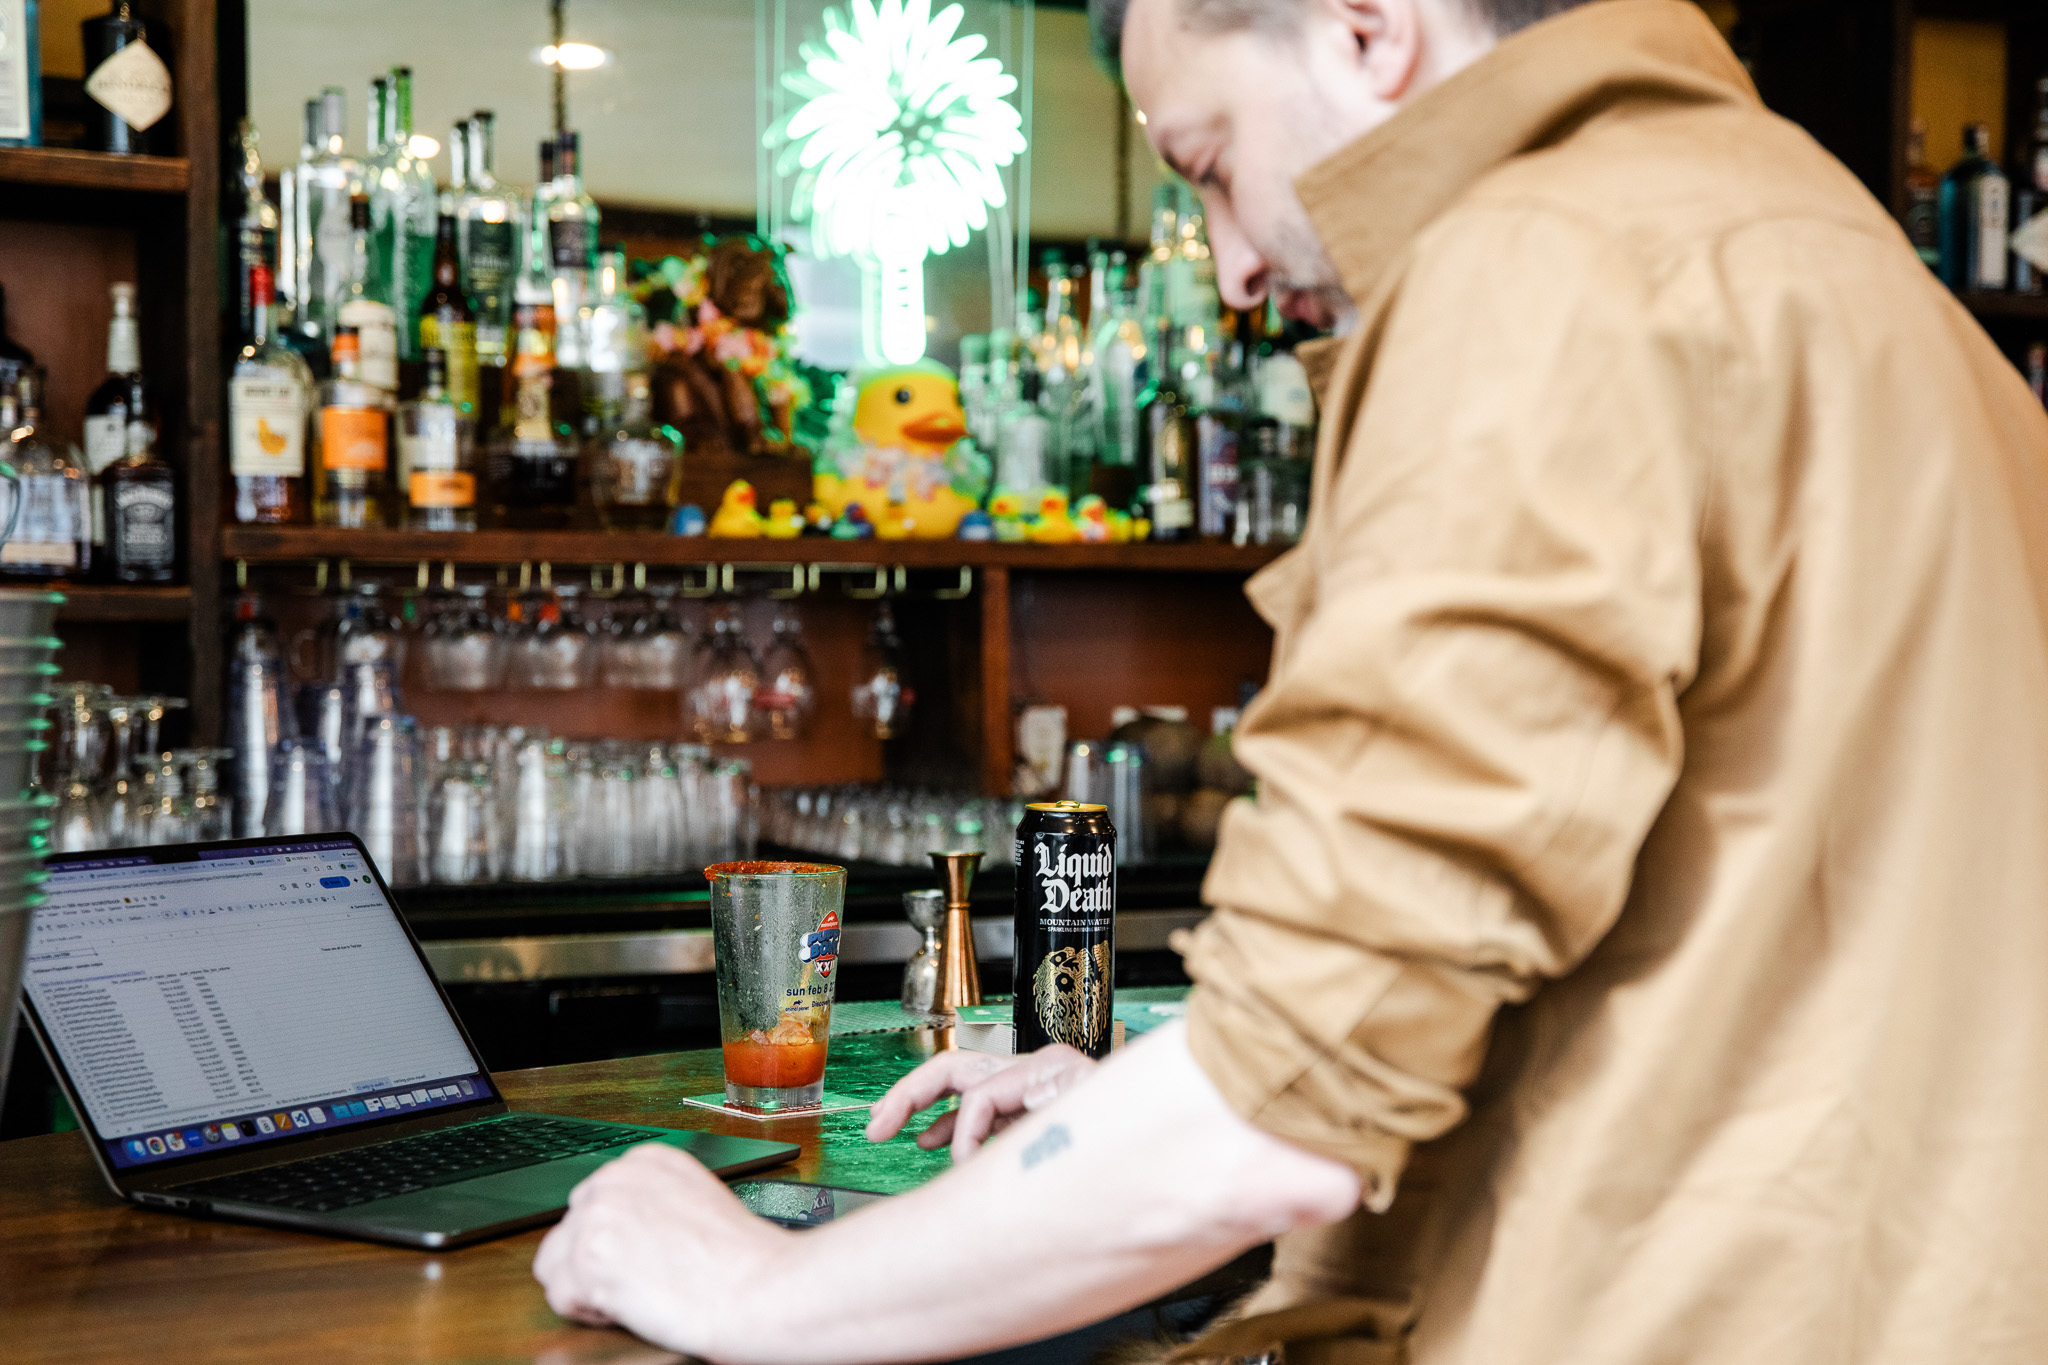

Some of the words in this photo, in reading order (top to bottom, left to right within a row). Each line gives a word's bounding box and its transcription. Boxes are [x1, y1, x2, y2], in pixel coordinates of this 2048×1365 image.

[1034, 842, 1112, 888] Liquid
[1040, 877, 1112, 913] Death
[1039, 918, 1087, 926] MOUNTAIN
[1087, 917, 1110, 925] WATER
[807, 929, 840, 947] PUPP
[810, 941, 839, 959] BOW
[786, 988, 805, 996] sun
[808, 984, 822, 995] feb
[823, 983, 828, 993] 8
